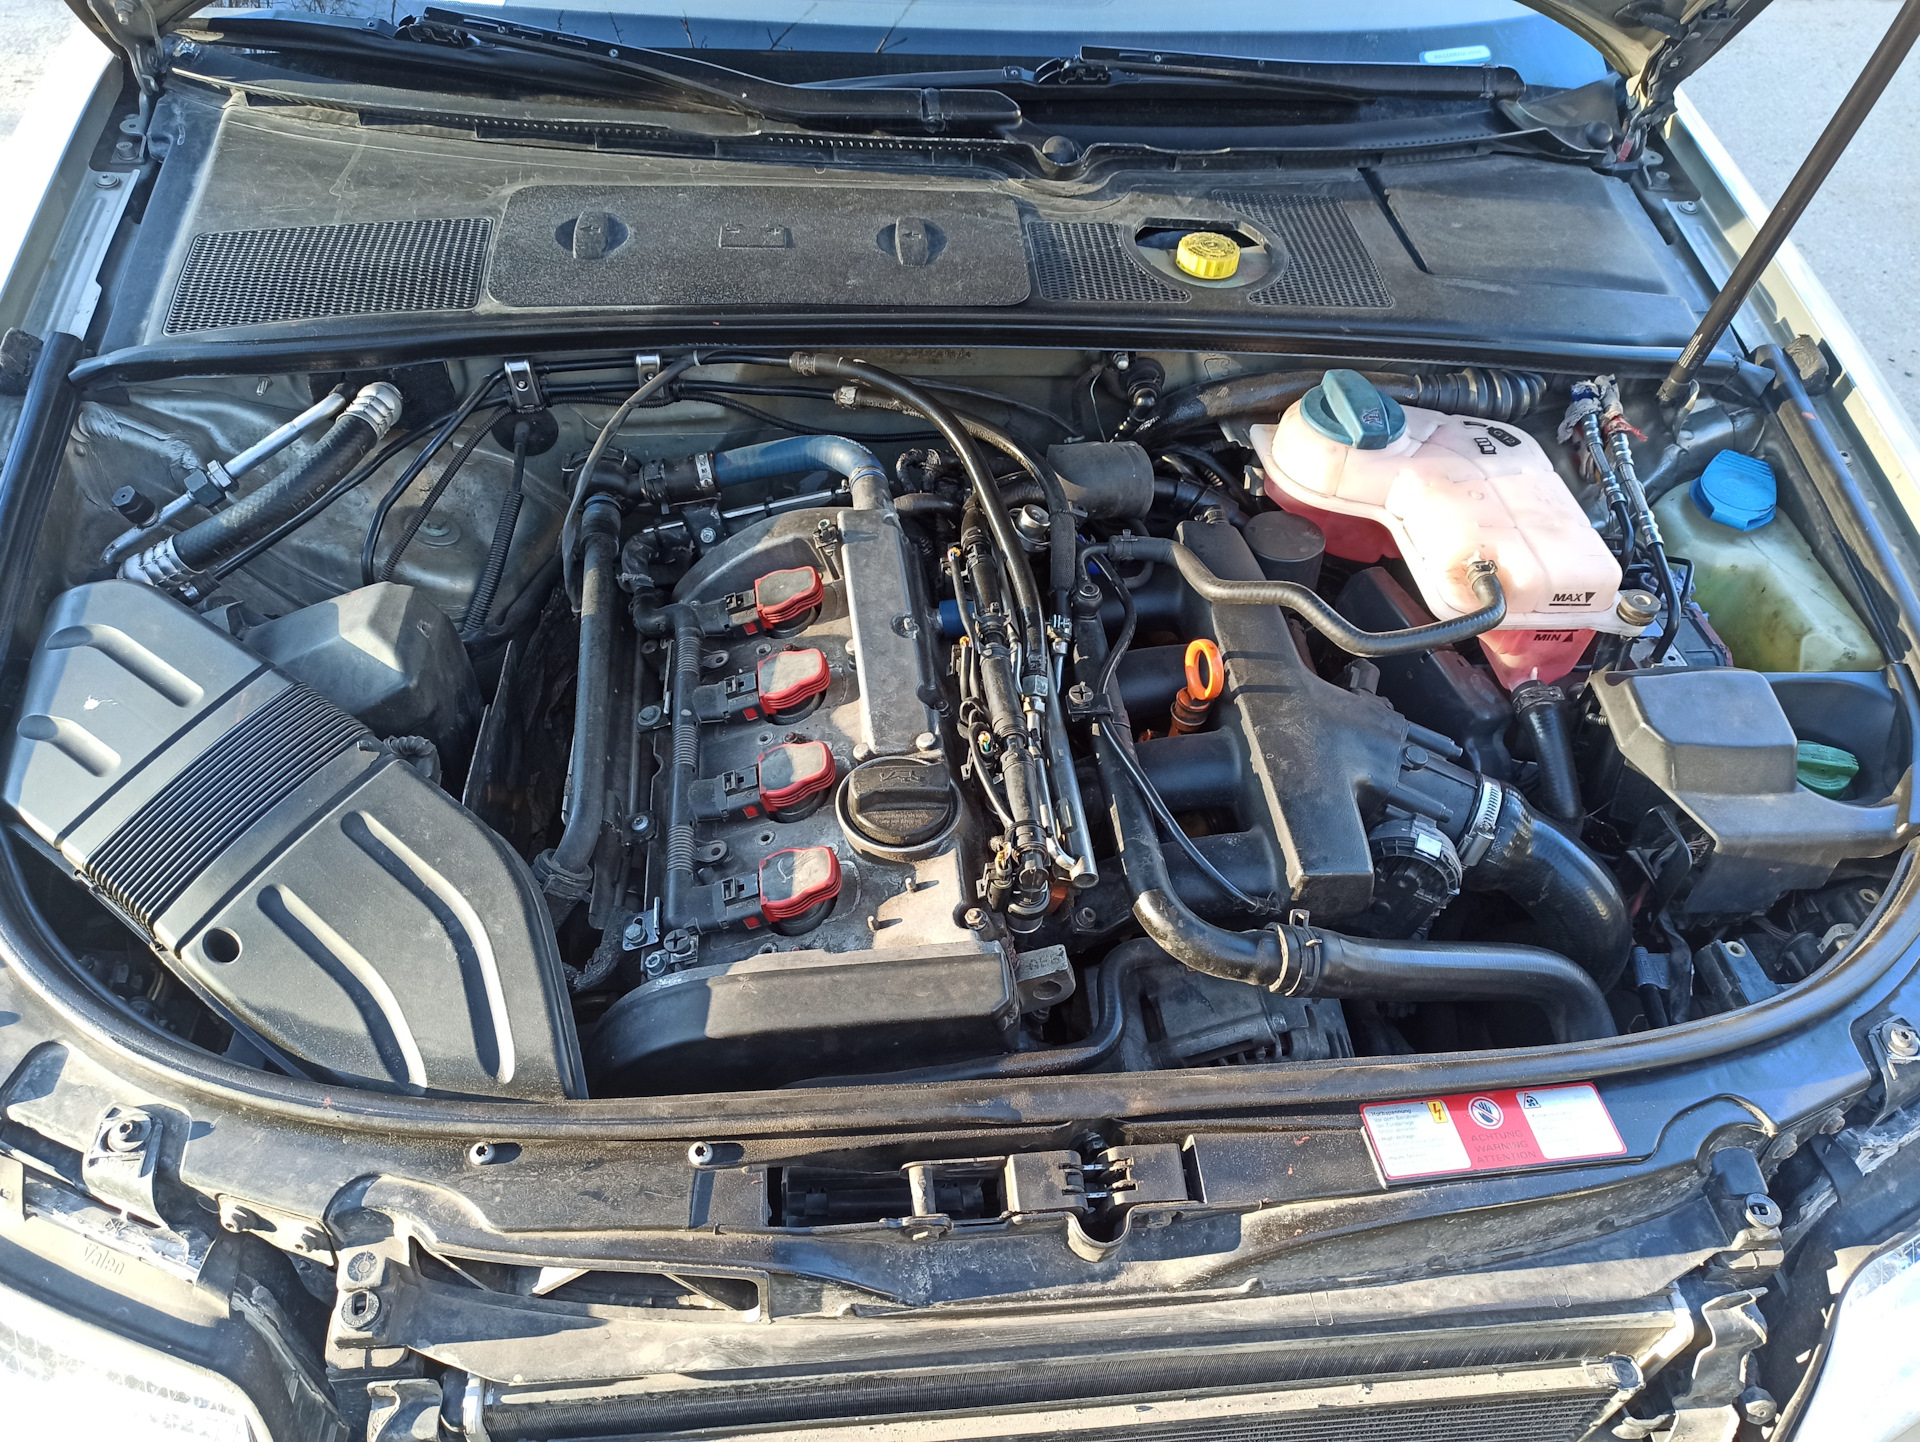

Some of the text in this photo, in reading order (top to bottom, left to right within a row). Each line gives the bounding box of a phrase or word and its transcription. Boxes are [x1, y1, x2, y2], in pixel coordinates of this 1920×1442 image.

[1552, 593, 1583, 602] MAX
[1533, 633, 1562, 642] MIN
[1471, 1129, 1523, 1142] ACHTUNG
[1474, 1140, 1529, 1153] WARNING
[1477, 1151, 1537, 1163] ATTENTION
[84, 1243, 125, 1276] Valeo
